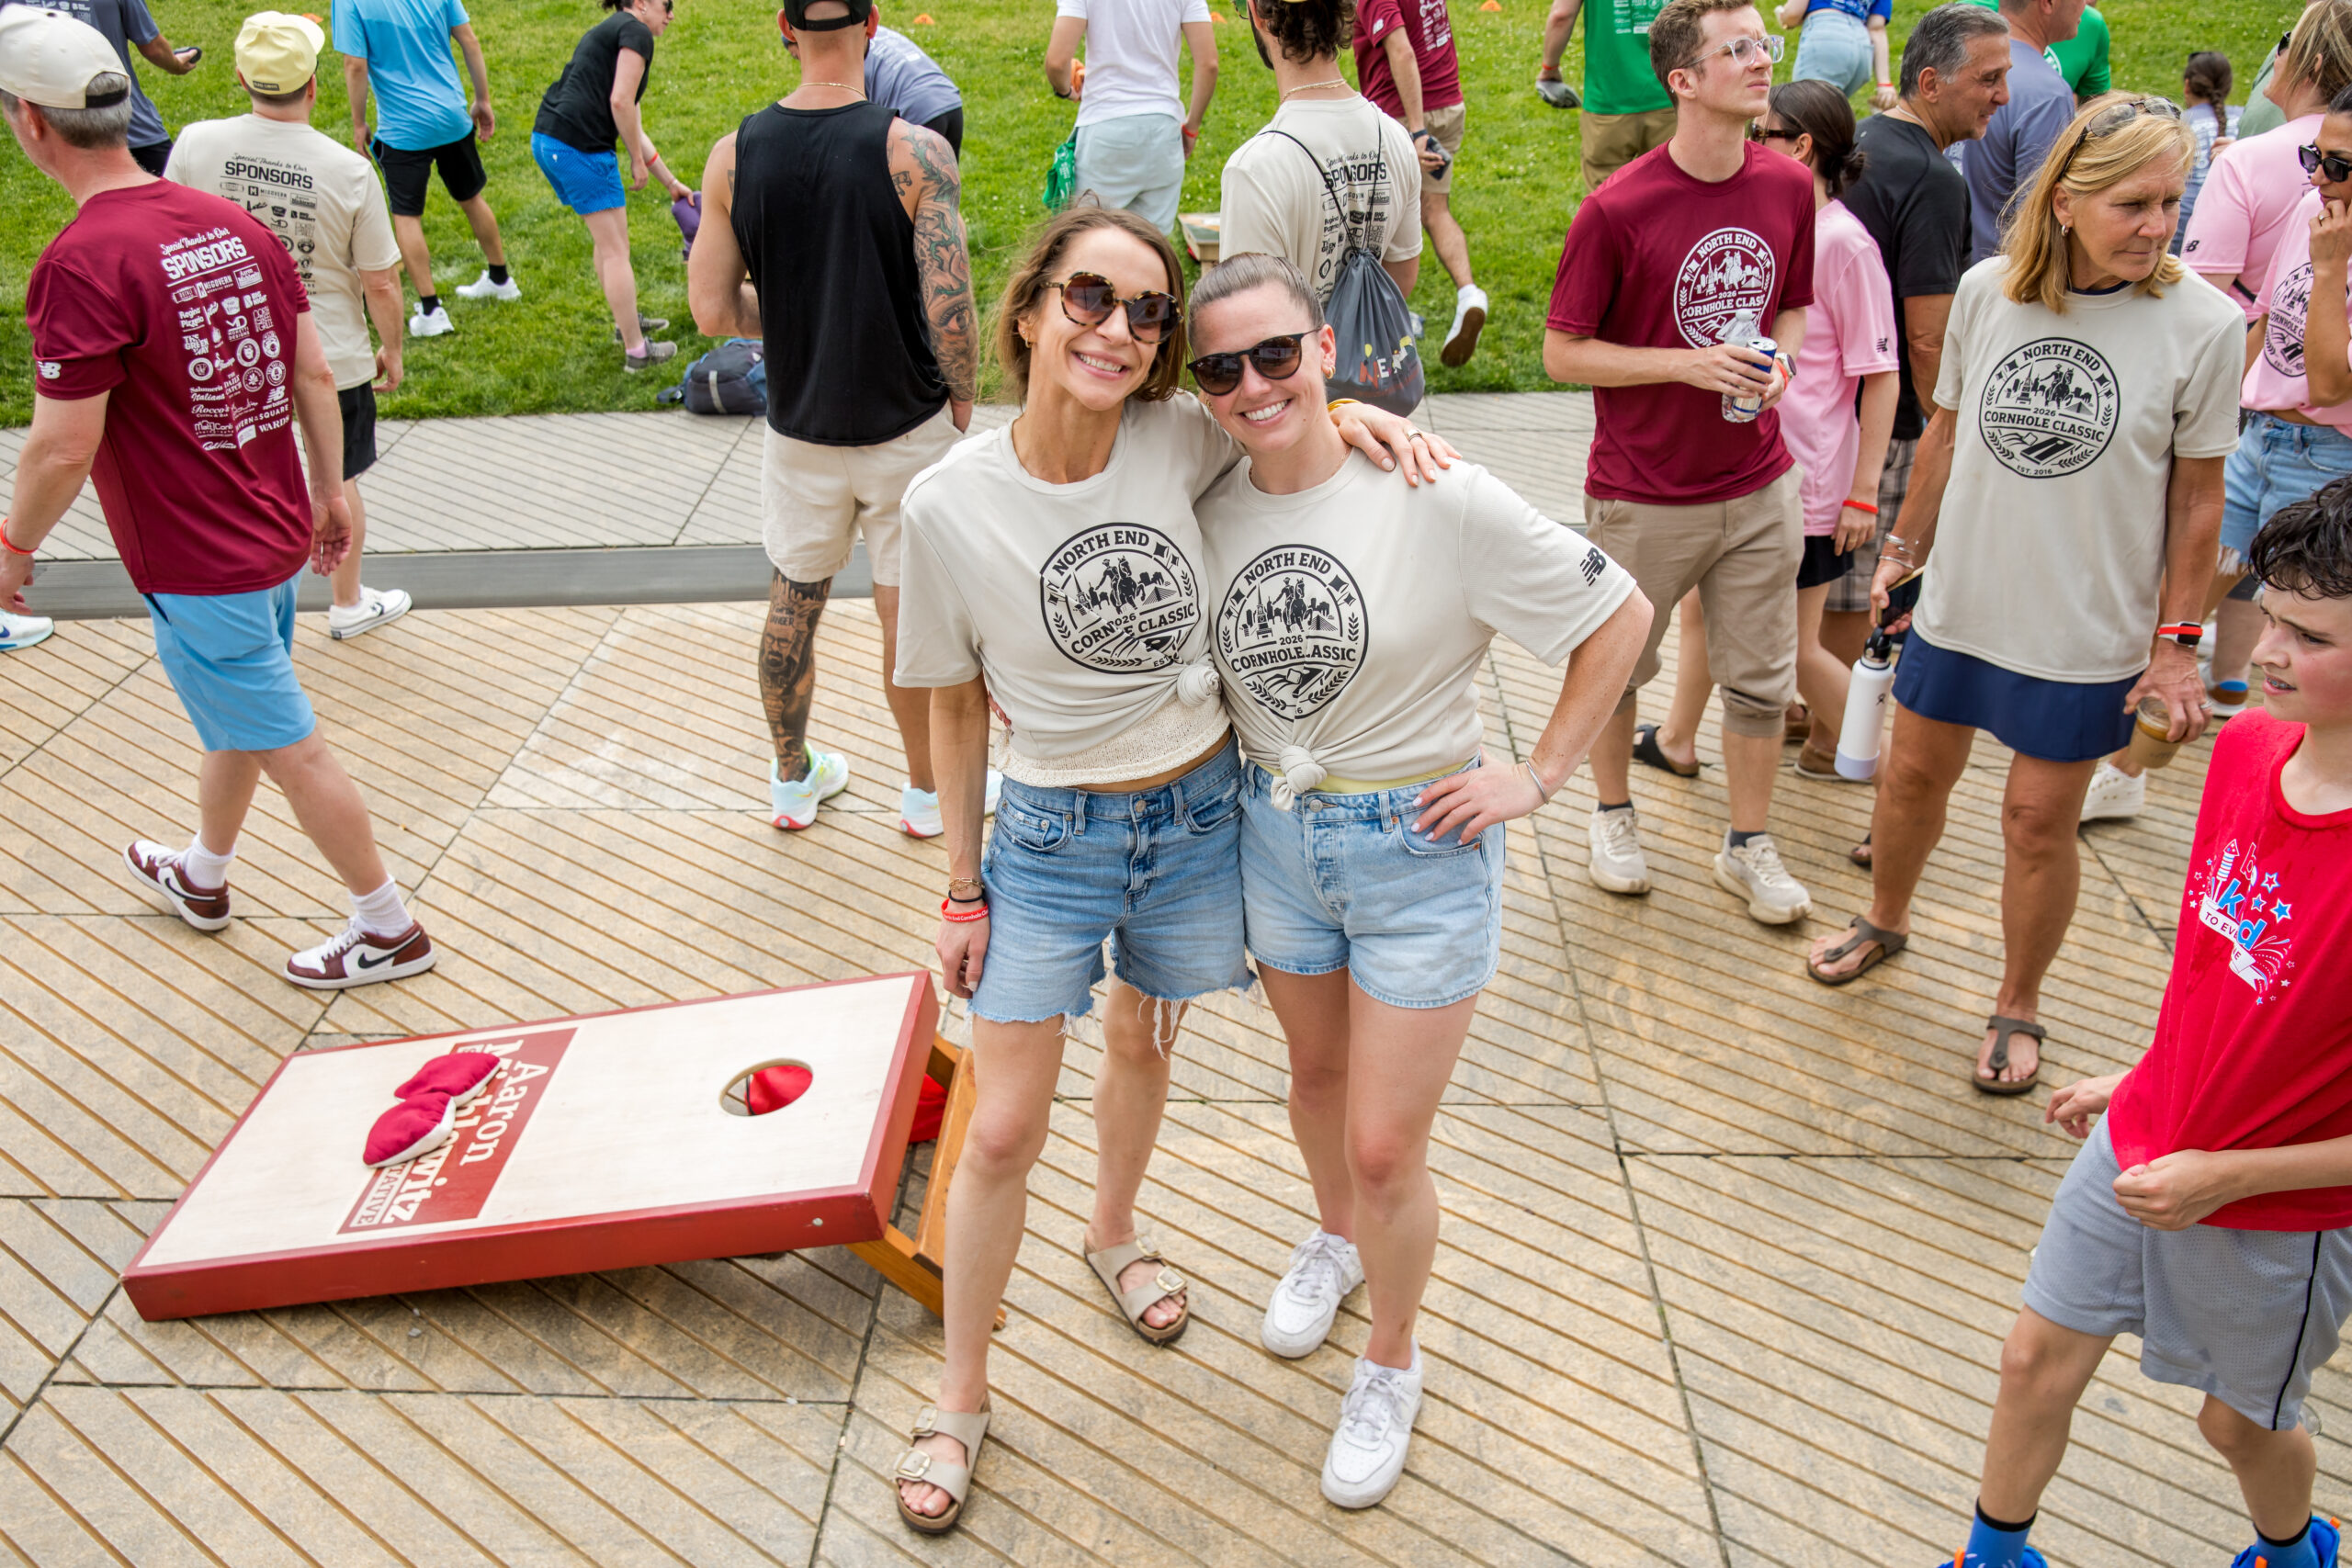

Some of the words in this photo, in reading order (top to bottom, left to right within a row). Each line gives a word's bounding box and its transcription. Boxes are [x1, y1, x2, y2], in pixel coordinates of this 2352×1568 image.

[232, 152, 257, 162] Special
[259, 157, 283, 167] Thanks
[224, 161, 313, 189] SPONSORS
[160, 240, 184, 256] Special
[182, 232, 207, 248] Thanks
[207, 231, 216, 240] to
[1697, 233, 1733, 258] NORTH
[1735, 233, 1758, 250] END
[162, 236, 247, 279] SPONSORS
[1718, 290, 1737, 299] 2026
[1681, 298, 1734, 319] CORNHOLE
[2023, 344, 2073, 361] NORTH
[2073, 348, 2100, 371] END
[259, 404, 288, 421] SQUARE
[2033, 407, 2056, 417] 2026
[1984, 411, 2050, 429] CORNHOLE
[2052, 420, 2105, 443] CLASSIC
[1052, 530, 1110, 576] NORTH
[1114, 530, 1149, 547] END
[1244, 552, 1295, 586] NORTH
[1298, 552, 1331, 575] END
[1071, 625, 1136, 654] CORNE
[1138, 603, 1194, 633] CLASSIC
[1279, 635, 1304, 646] 2026
[1230, 646, 1306, 672] CORNHOLE
[1306, 645, 1356, 661] ASSIC
[2204, 911, 2219, 926] TO
[459, 1061, 549, 1166] Aaron
